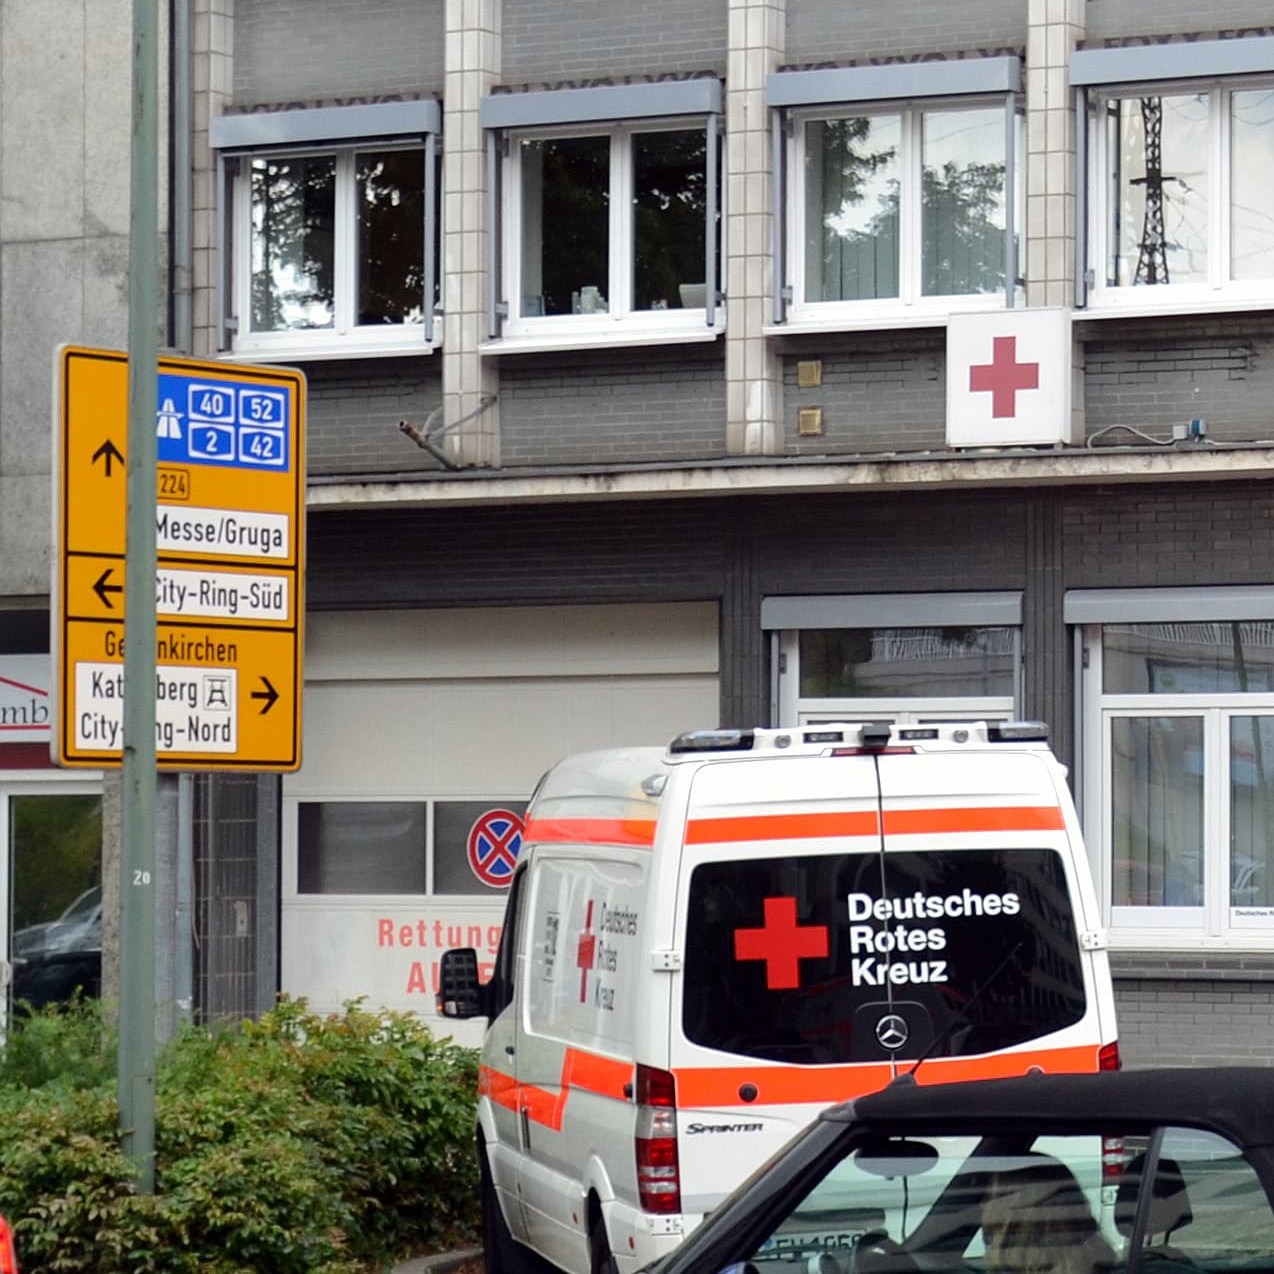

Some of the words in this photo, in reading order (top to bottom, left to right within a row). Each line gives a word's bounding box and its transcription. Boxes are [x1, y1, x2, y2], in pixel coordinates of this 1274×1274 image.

[199, 393, 224, 416] 40
[250, 396, 274, 421] 52
[205, 431, 218, 453] 2
[250, 436, 274, 458] 42
[160, 474, 186, 495] 224
[156, 513, 282, 554] Messe/Gruga
[104, 630, 238, 663] Genkirchen
[92, 671, 198, 708] Katberg
[133, 870, 151, 886] 20
[847, 888, 1021, 922] Deutsches
[849, 924, 947, 954] Rotes
[851, 955, 949, 987] Kreuz
